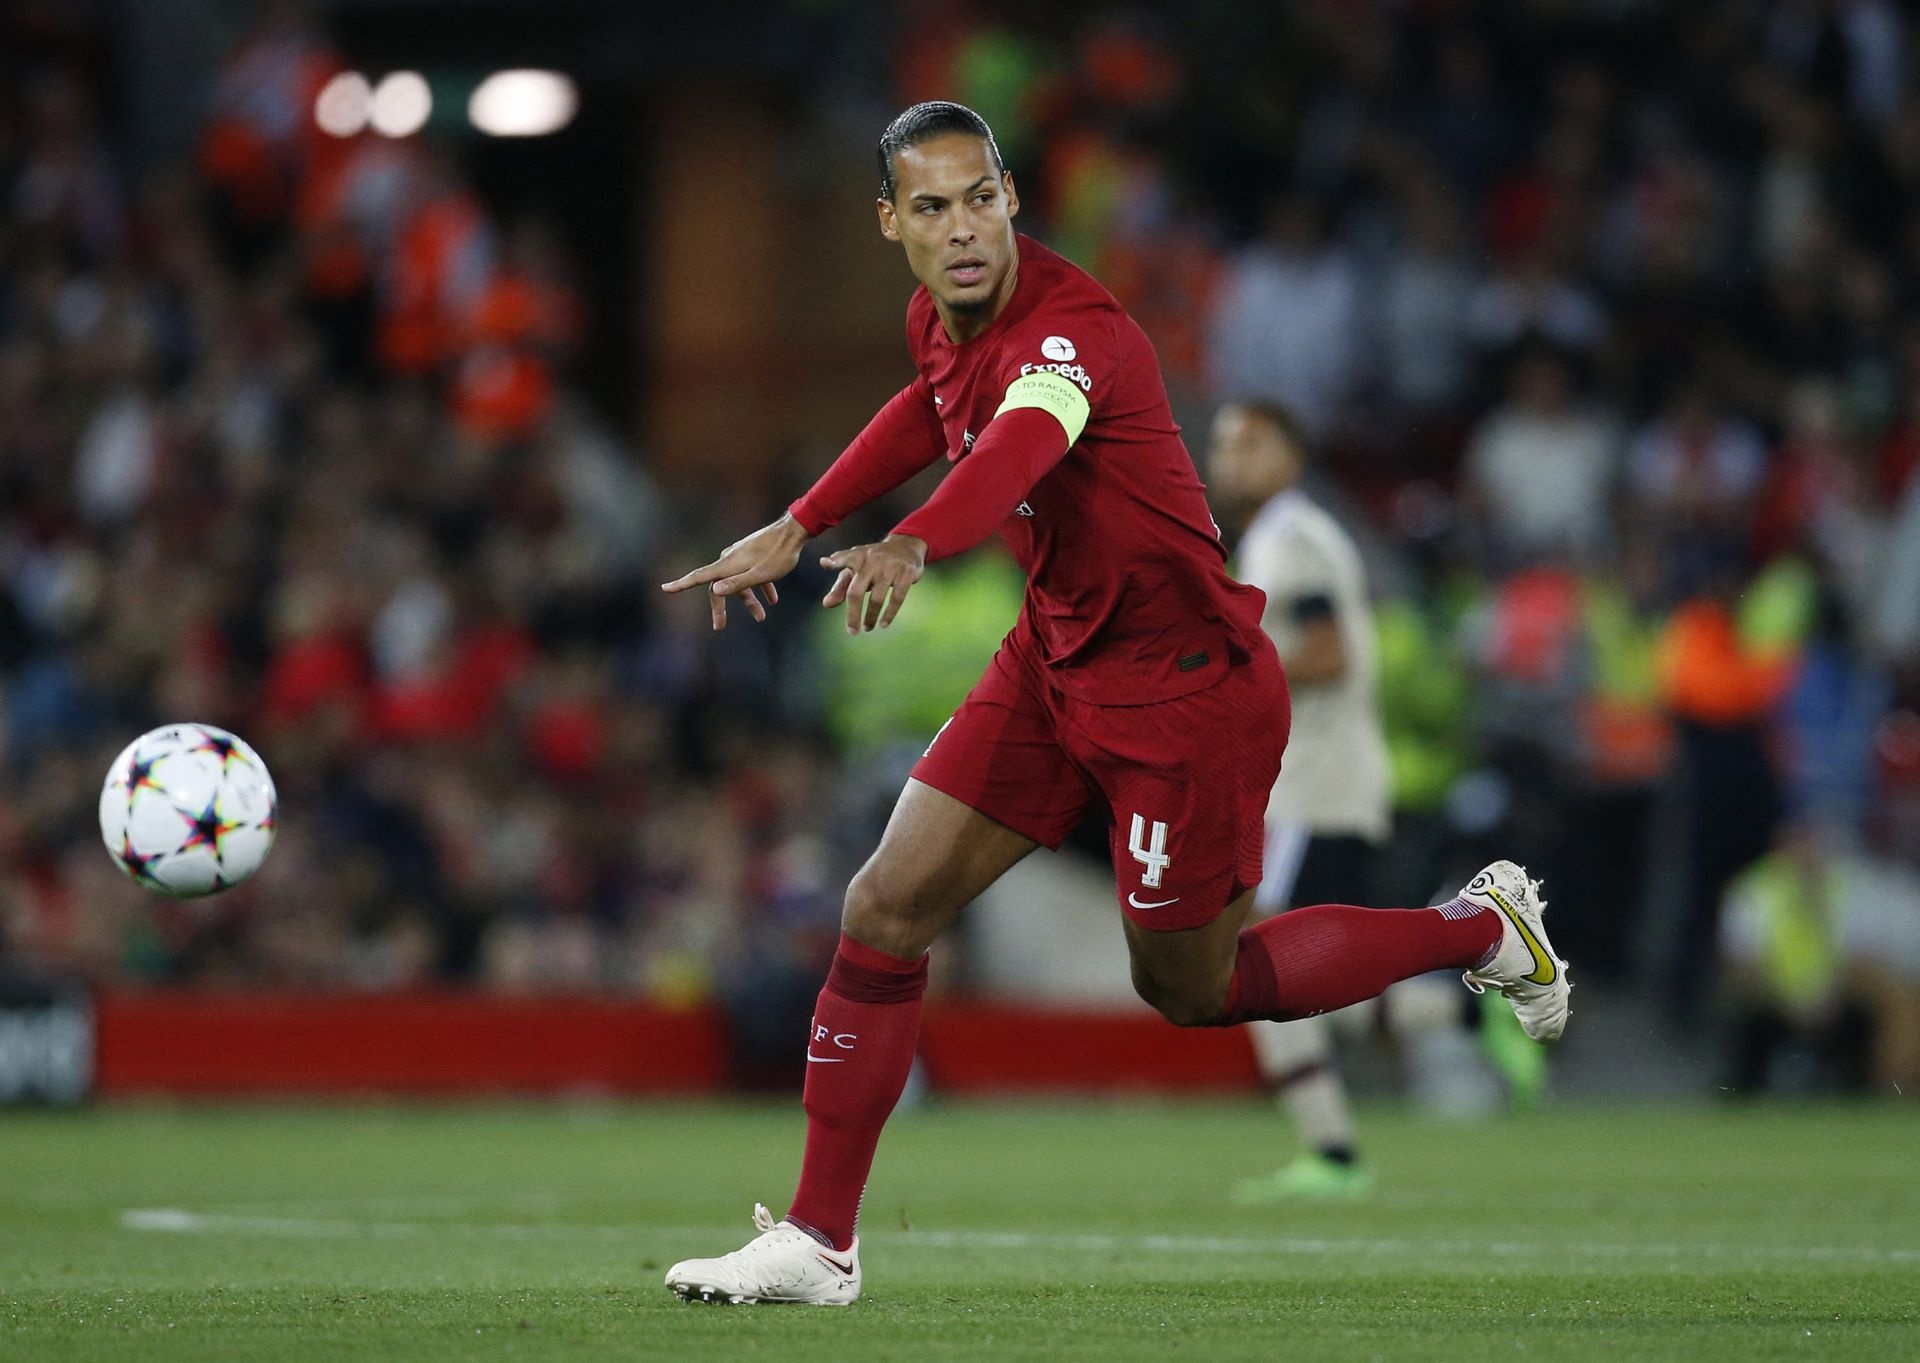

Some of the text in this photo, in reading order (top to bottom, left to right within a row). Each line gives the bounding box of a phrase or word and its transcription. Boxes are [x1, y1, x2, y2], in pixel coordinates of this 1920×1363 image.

[1020, 362, 1092, 392] Expedia
[1022, 381, 1036, 390] TO
[1038, 382, 1076, 403] RACISM
[1128, 811, 1171, 889] 4
[811, 1017, 857, 1049] FC
